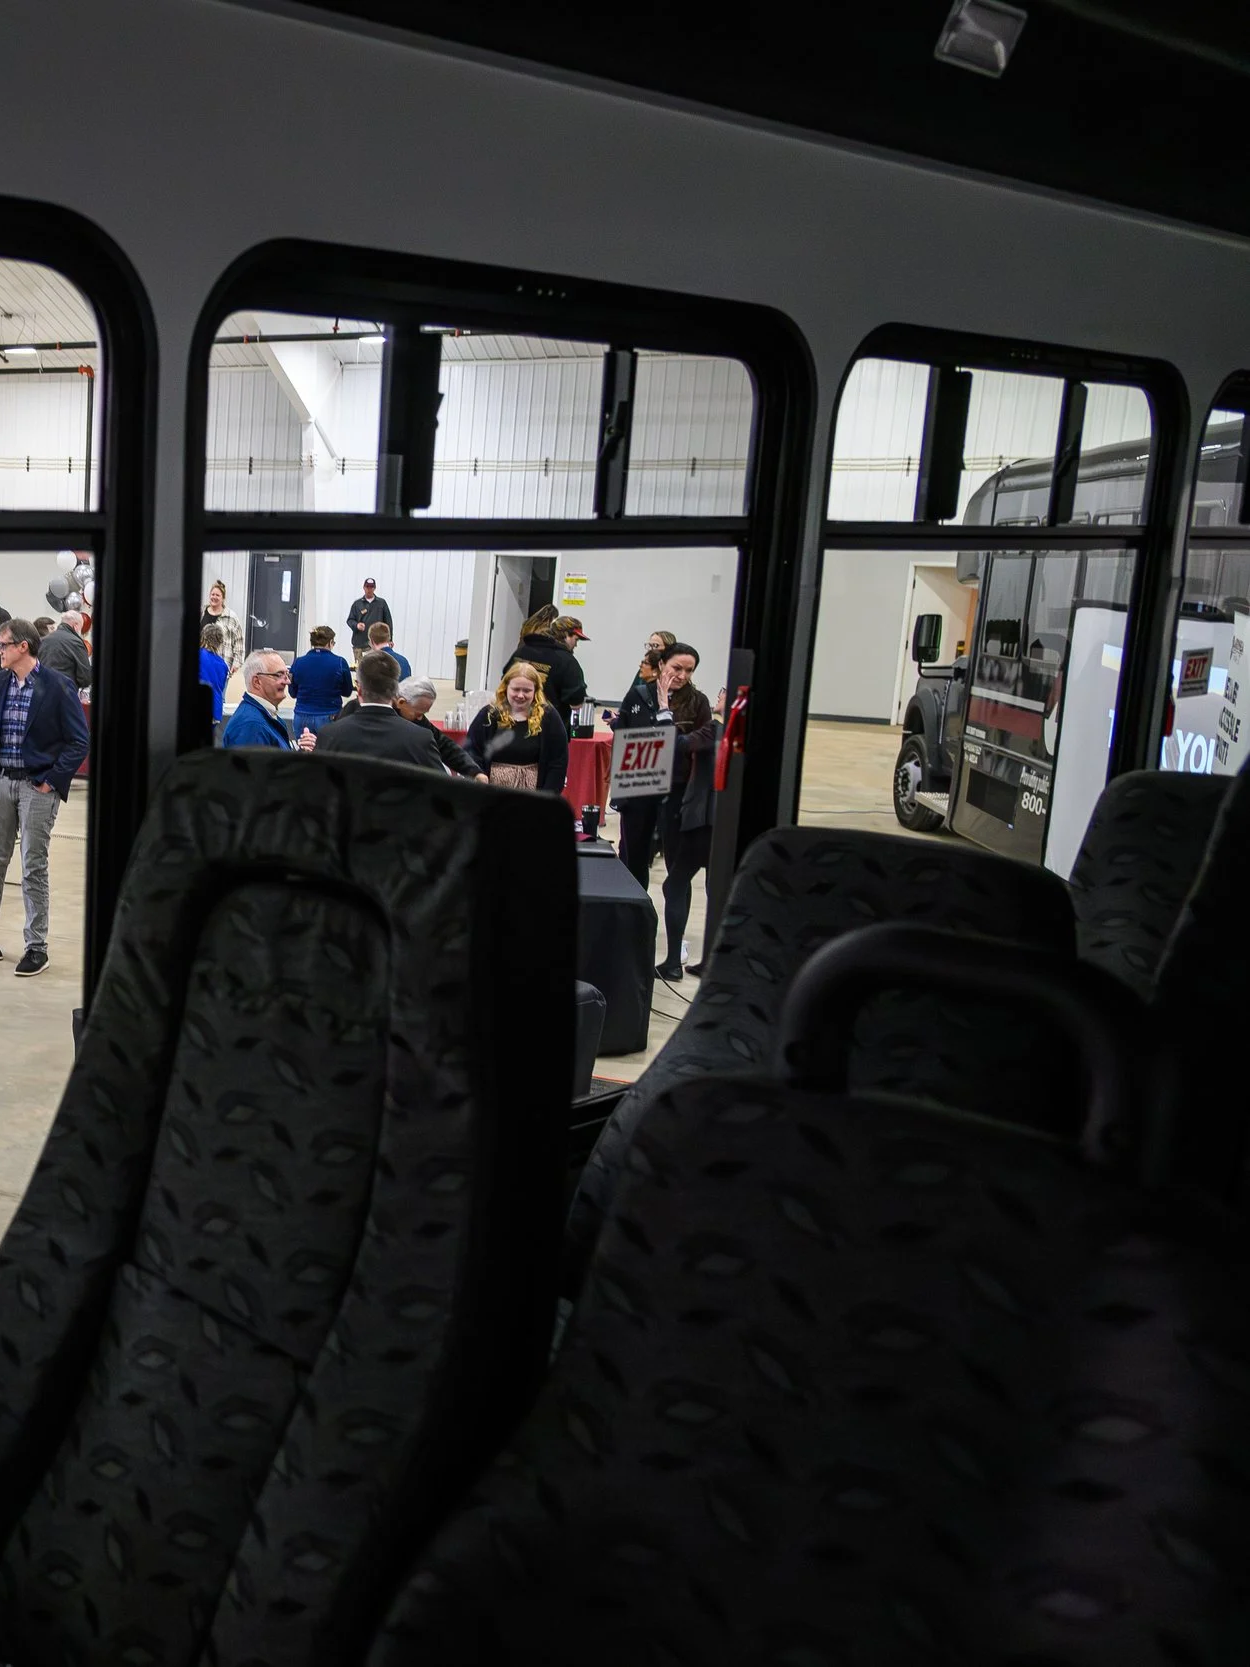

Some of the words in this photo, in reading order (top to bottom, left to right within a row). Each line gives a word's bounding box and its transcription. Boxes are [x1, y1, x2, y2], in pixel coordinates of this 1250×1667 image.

[1184, 656, 1209, 679] EXIT
[620, 740, 664, 771] EXIT
[1021, 791, 1047, 816] 800-
